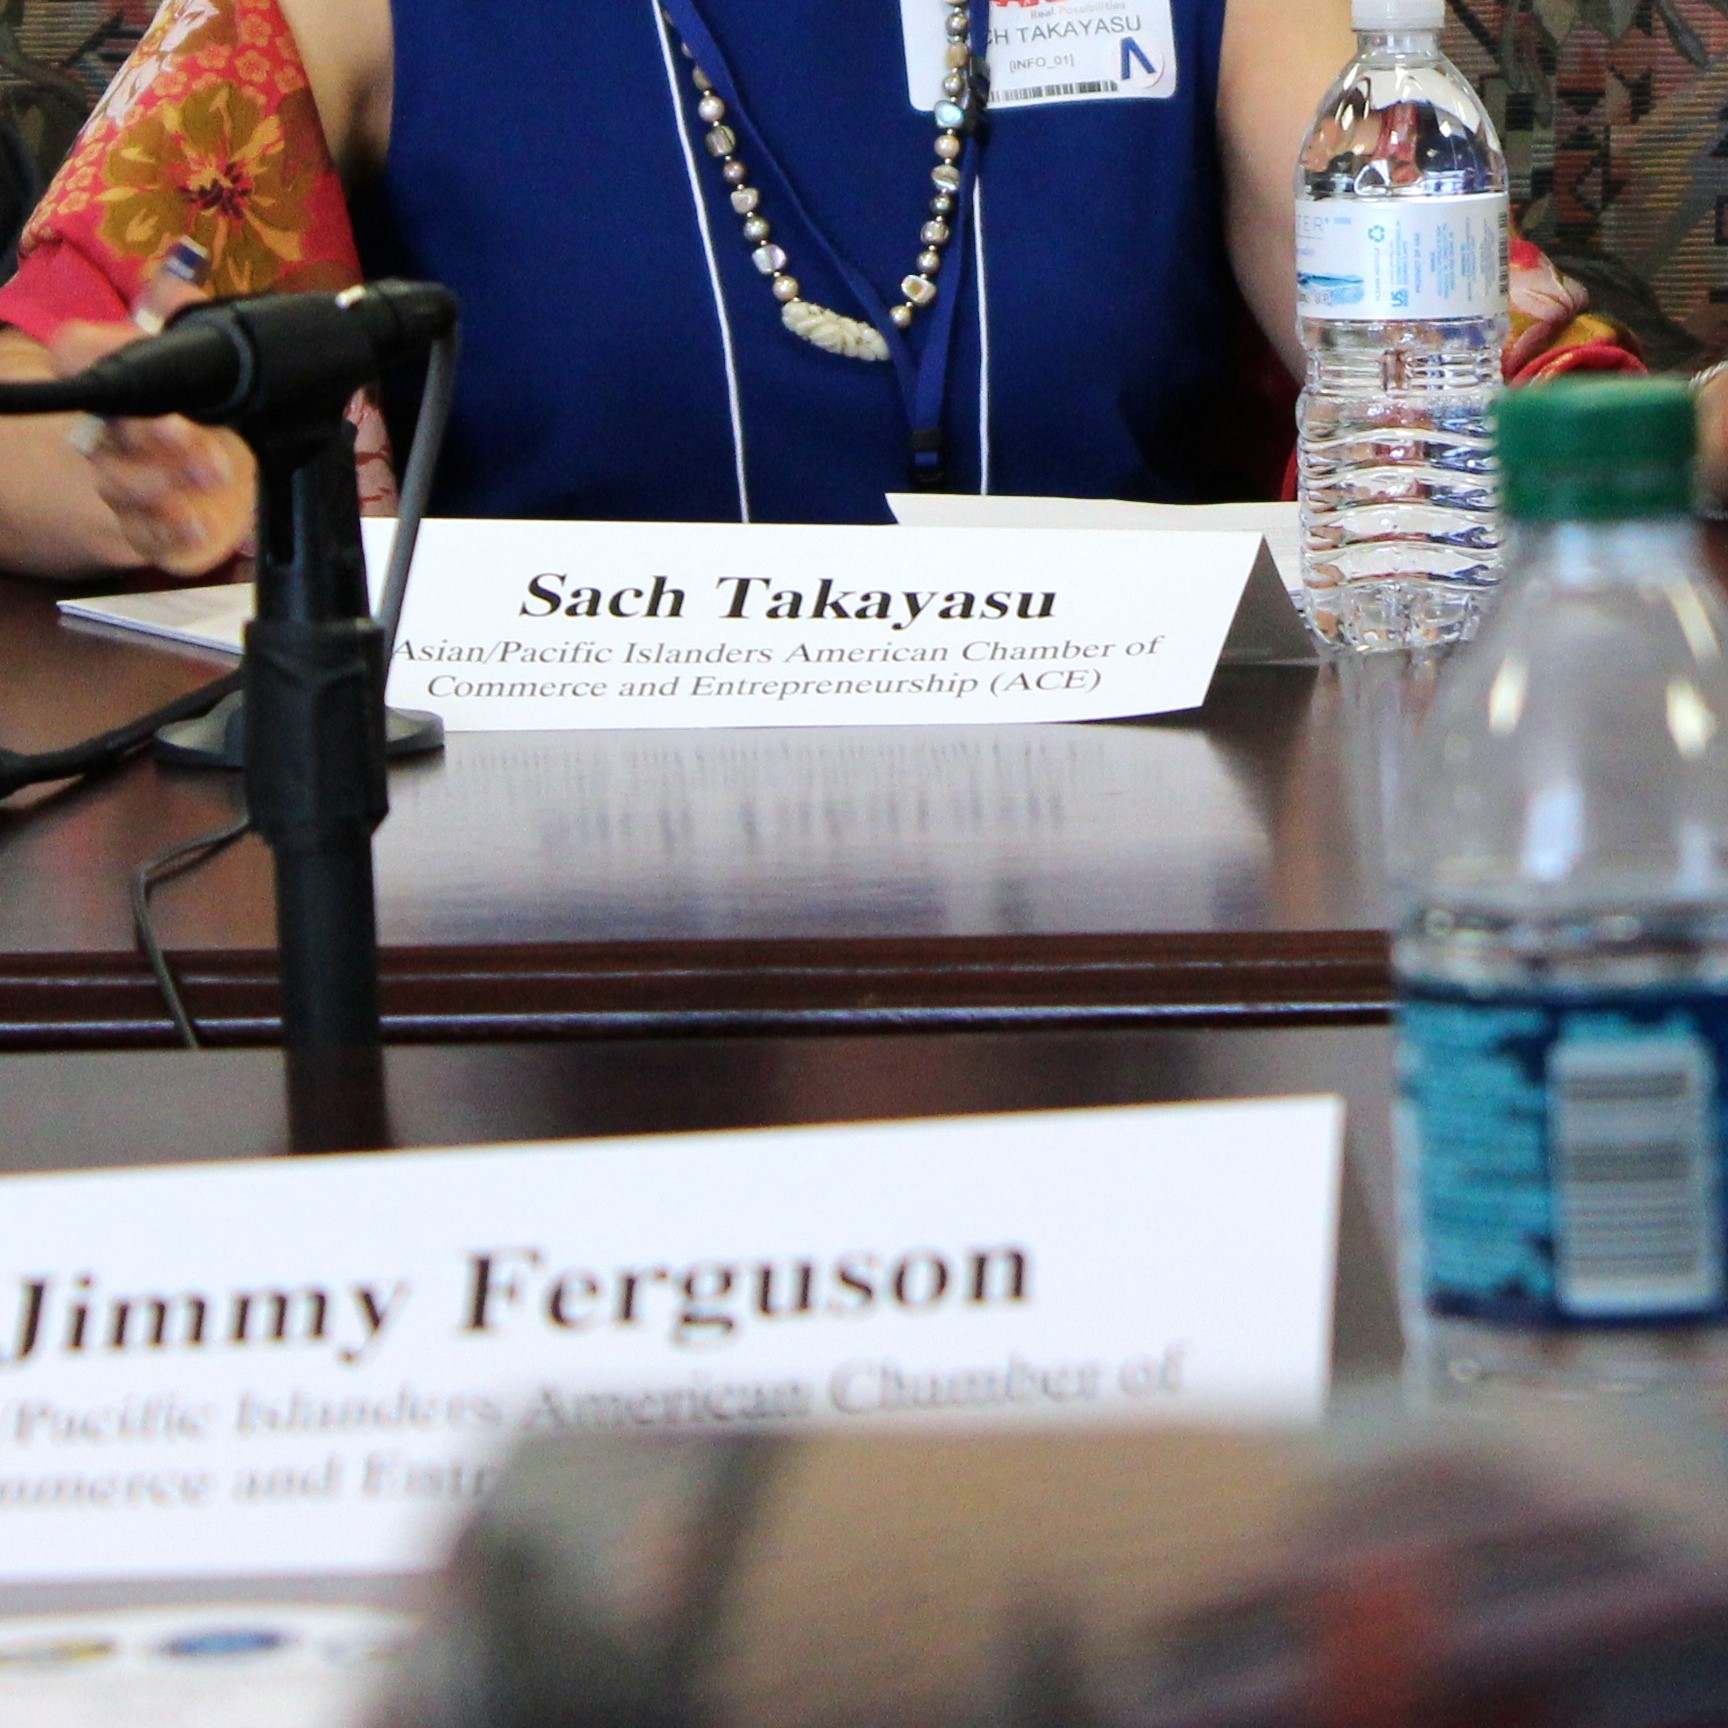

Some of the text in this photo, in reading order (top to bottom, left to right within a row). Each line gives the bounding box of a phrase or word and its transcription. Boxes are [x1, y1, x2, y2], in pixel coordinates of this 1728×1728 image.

[1016, 14, 1142, 42] TAKAYASU
[1009, 53, 1075, 73] [INFO_01]
[518, 572, 1058, 632] Sach Takayasu
[391, 635, 1166, 666] Asian/Pacific Islanders American Chamber of
[426, 668, 1104, 702] Commerce and Entrepreneurship (ACE)
[454, 1239, 1038, 1346] Ferguson
[235, 1379, 505, 1438] Islanders
[522, 1368, 813, 1431] American
[827, 1352, 1102, 1416] Chamber
[1115, 1341, 1194, 1399] of
[230, 1453, 344, 1502] and
